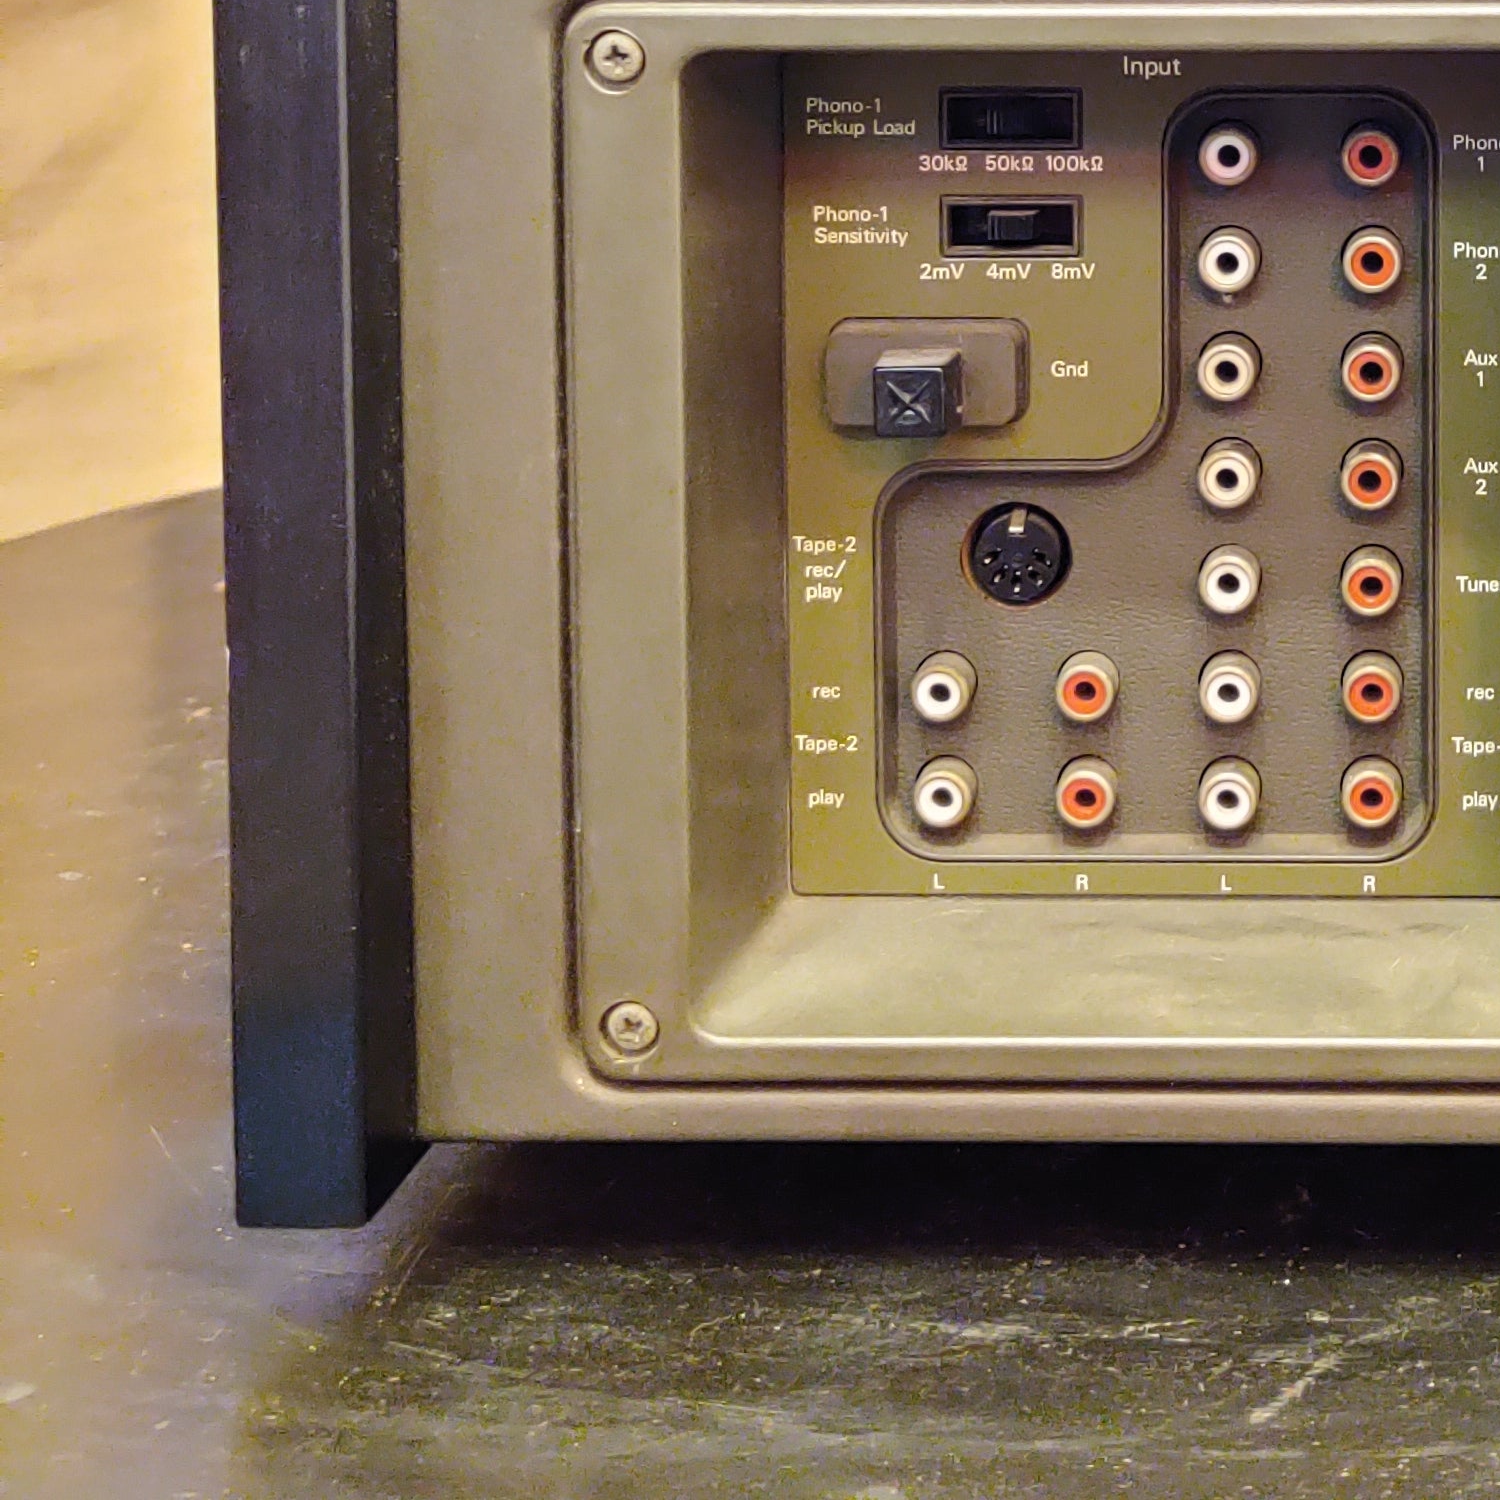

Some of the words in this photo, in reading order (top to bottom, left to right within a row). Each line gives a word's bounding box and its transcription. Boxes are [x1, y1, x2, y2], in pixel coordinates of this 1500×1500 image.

[1123, 55, 1181, 80] Input
[806, 97, 881, 113] Phono-1
[806, 119, 866, 139] Pickup
[873, 119, 916, 136] Load
[1477, 155, 1484, 172] 1
[813, 205, 888, 222] Phono-1
[814, 226, 909, 248] Sensitivity
[919, 262, 966, 281] 2mV
[985, 262, 1032, 281] 4mV
[1050, 262, 1097, 281] 8mV
[1475, 263, 1488, 280] 2
[1463, 348, 1498, 366] Aux
[1050, 360, 1089, 378] Gnd
[1476, 370, 1484, 387] 1
[1463, 457, 1499, 474] Aux
[1475, 478, 1488, 496] 2
[792, 535, 857, 556] Tape-2
[805, 559, 847, 579] rec/
[805, 582, 843, 603] play
[812, 686, 841, 699] rec
[1466, 687, 1495, 701] rec
[794, 734, 858, 755] Tape-2
[808, 788, 845, 809] play
[1462, 790, 1499, 811] play
[933, 873, 946, 890] L
[1075, 873, 1089, 891] R
[1220, 874, 1233, 892] L
[1363, 874, 1376, 893] R
